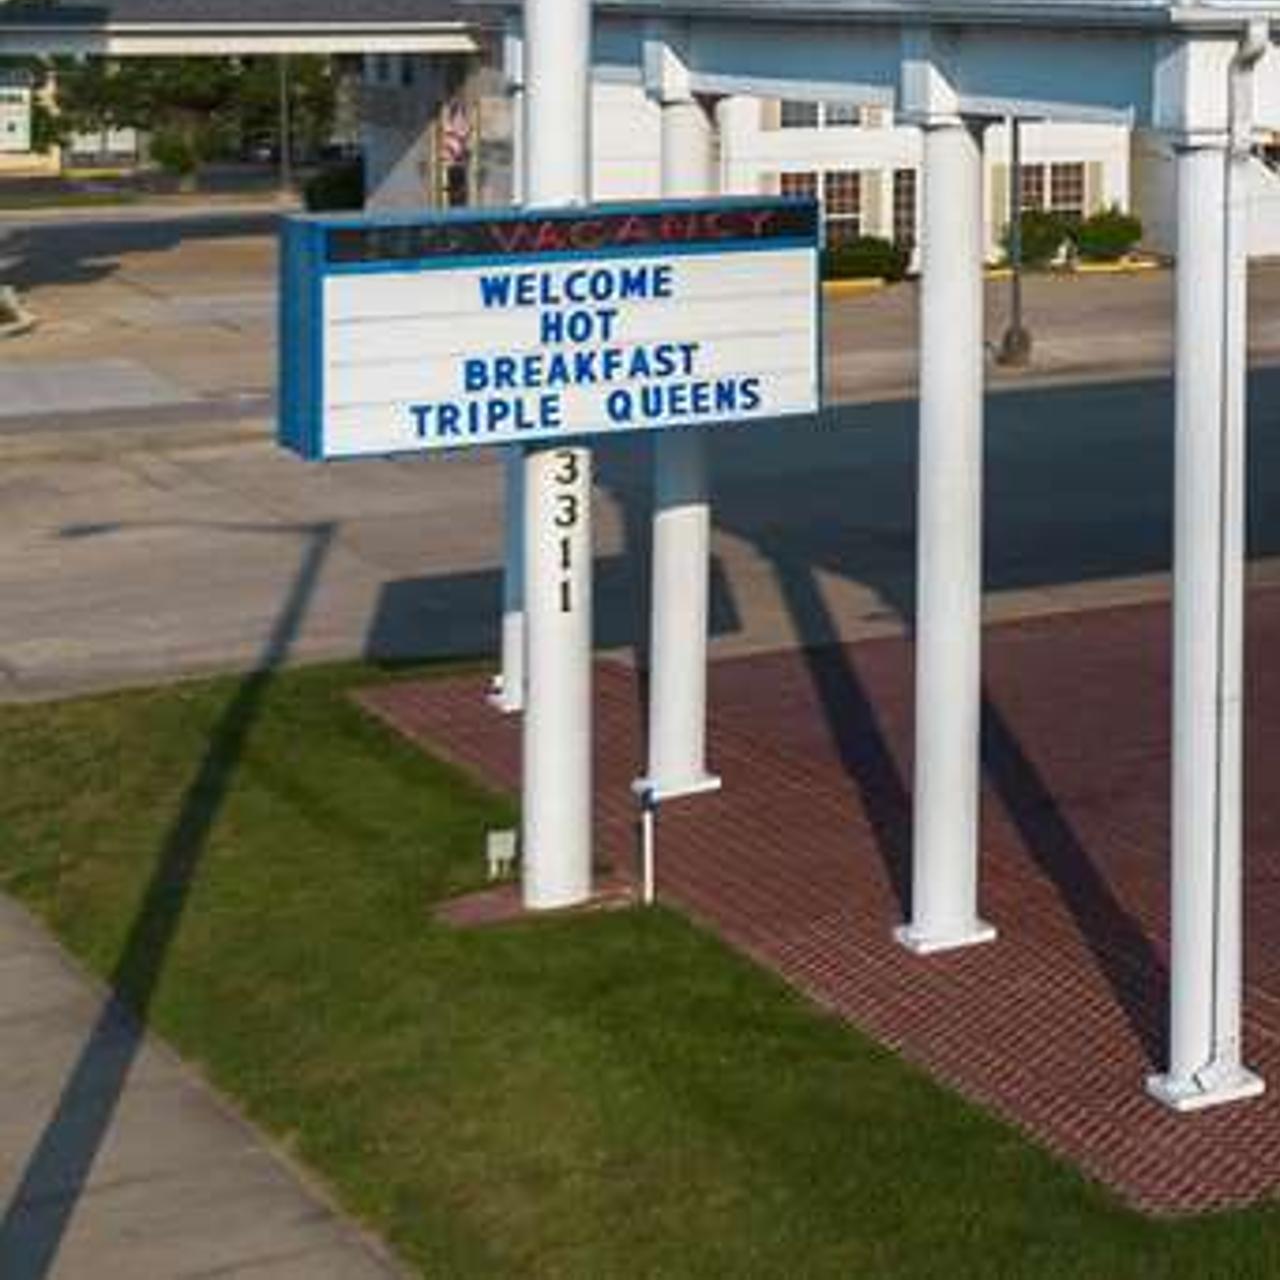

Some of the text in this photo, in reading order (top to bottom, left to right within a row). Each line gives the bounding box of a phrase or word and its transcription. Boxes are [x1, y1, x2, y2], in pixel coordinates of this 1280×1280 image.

[480, 266, 673, 307] WELCOME
[540, 310, 618, 344] HOT
[465, 345, 698, 391] BREAKFAST
[411, 379, 761, 438] TRIPLE QUEENS
[554, 452, 580, 613] 3311
